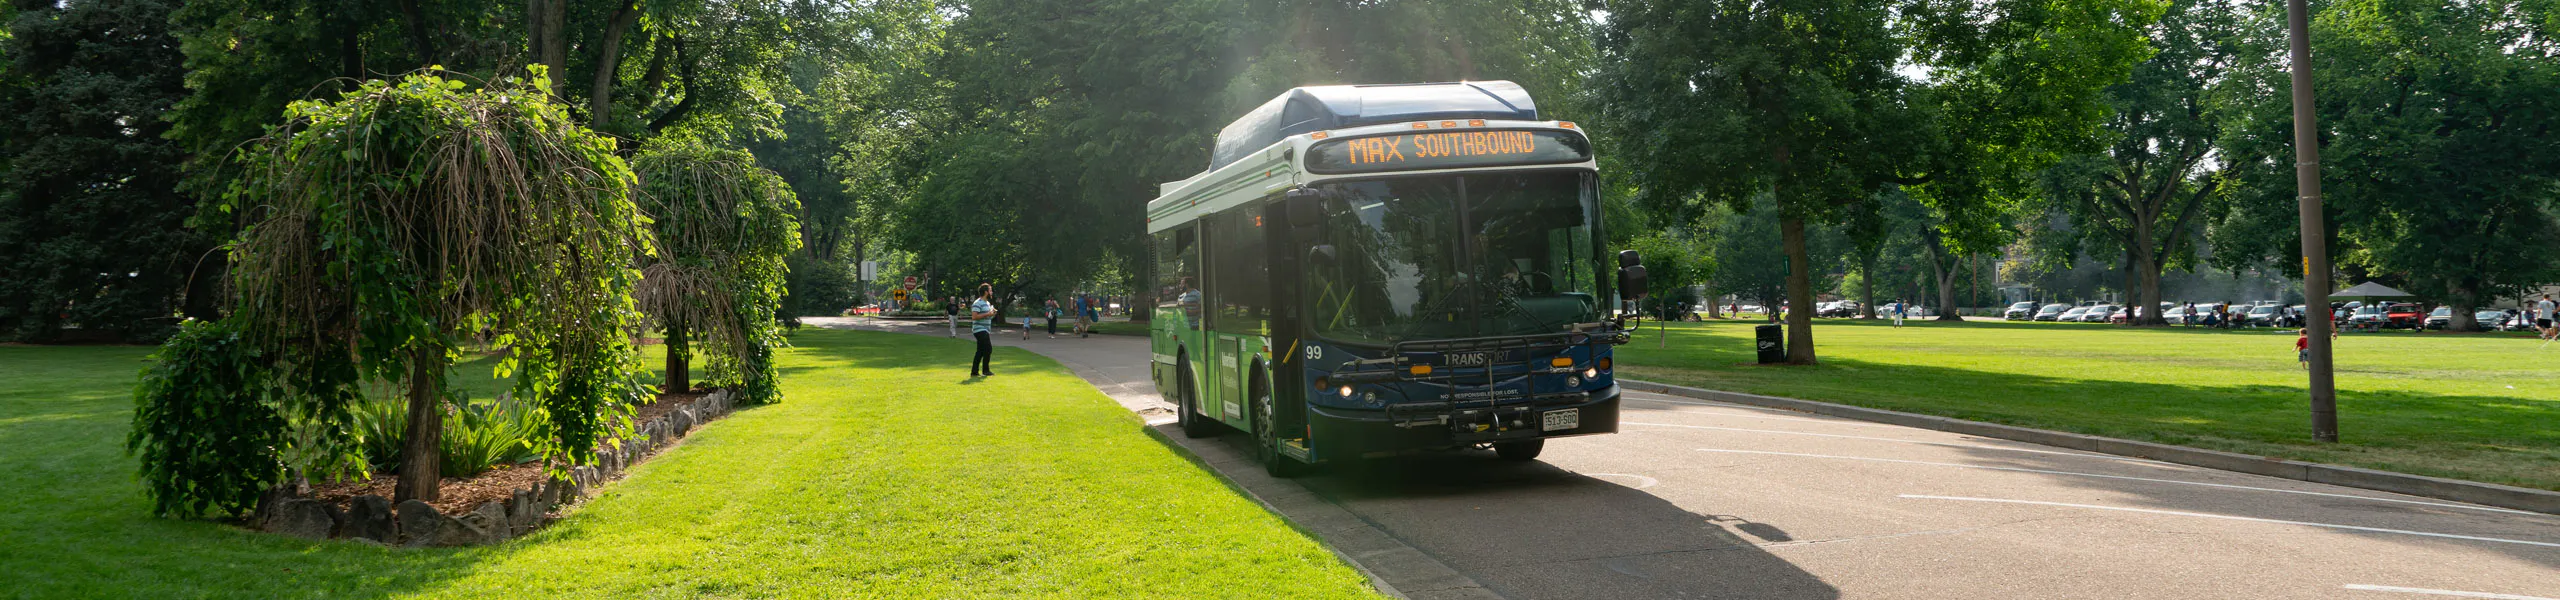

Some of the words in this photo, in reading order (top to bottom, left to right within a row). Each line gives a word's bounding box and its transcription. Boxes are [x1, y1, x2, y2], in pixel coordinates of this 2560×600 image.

[1349, 138, 1404, 164] MAX
[1413, 131, 1535, 158] SOUTHBOUND
[1306, 345, 1322, 360] 99
